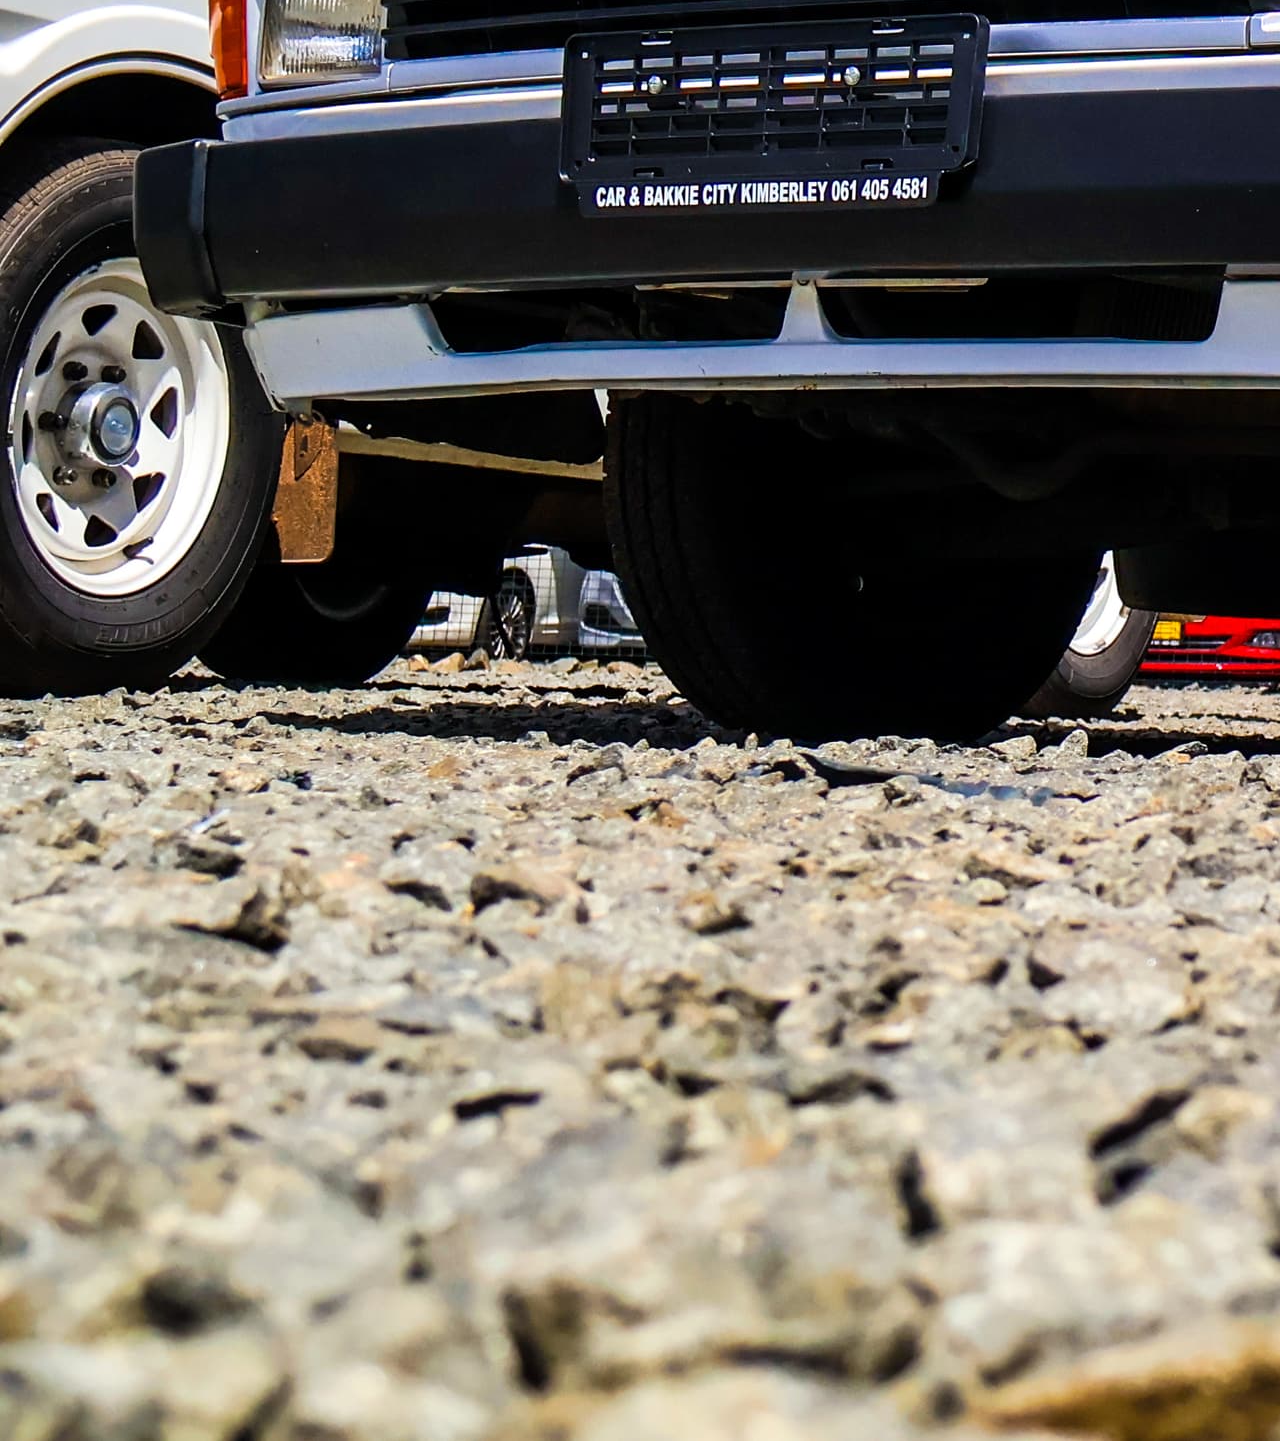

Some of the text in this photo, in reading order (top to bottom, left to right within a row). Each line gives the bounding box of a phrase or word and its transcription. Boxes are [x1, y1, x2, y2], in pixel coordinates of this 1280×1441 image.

[596, 177, 928, 207] CAR & BAKKIE CITY KIMBERLEY 061 405 4581
